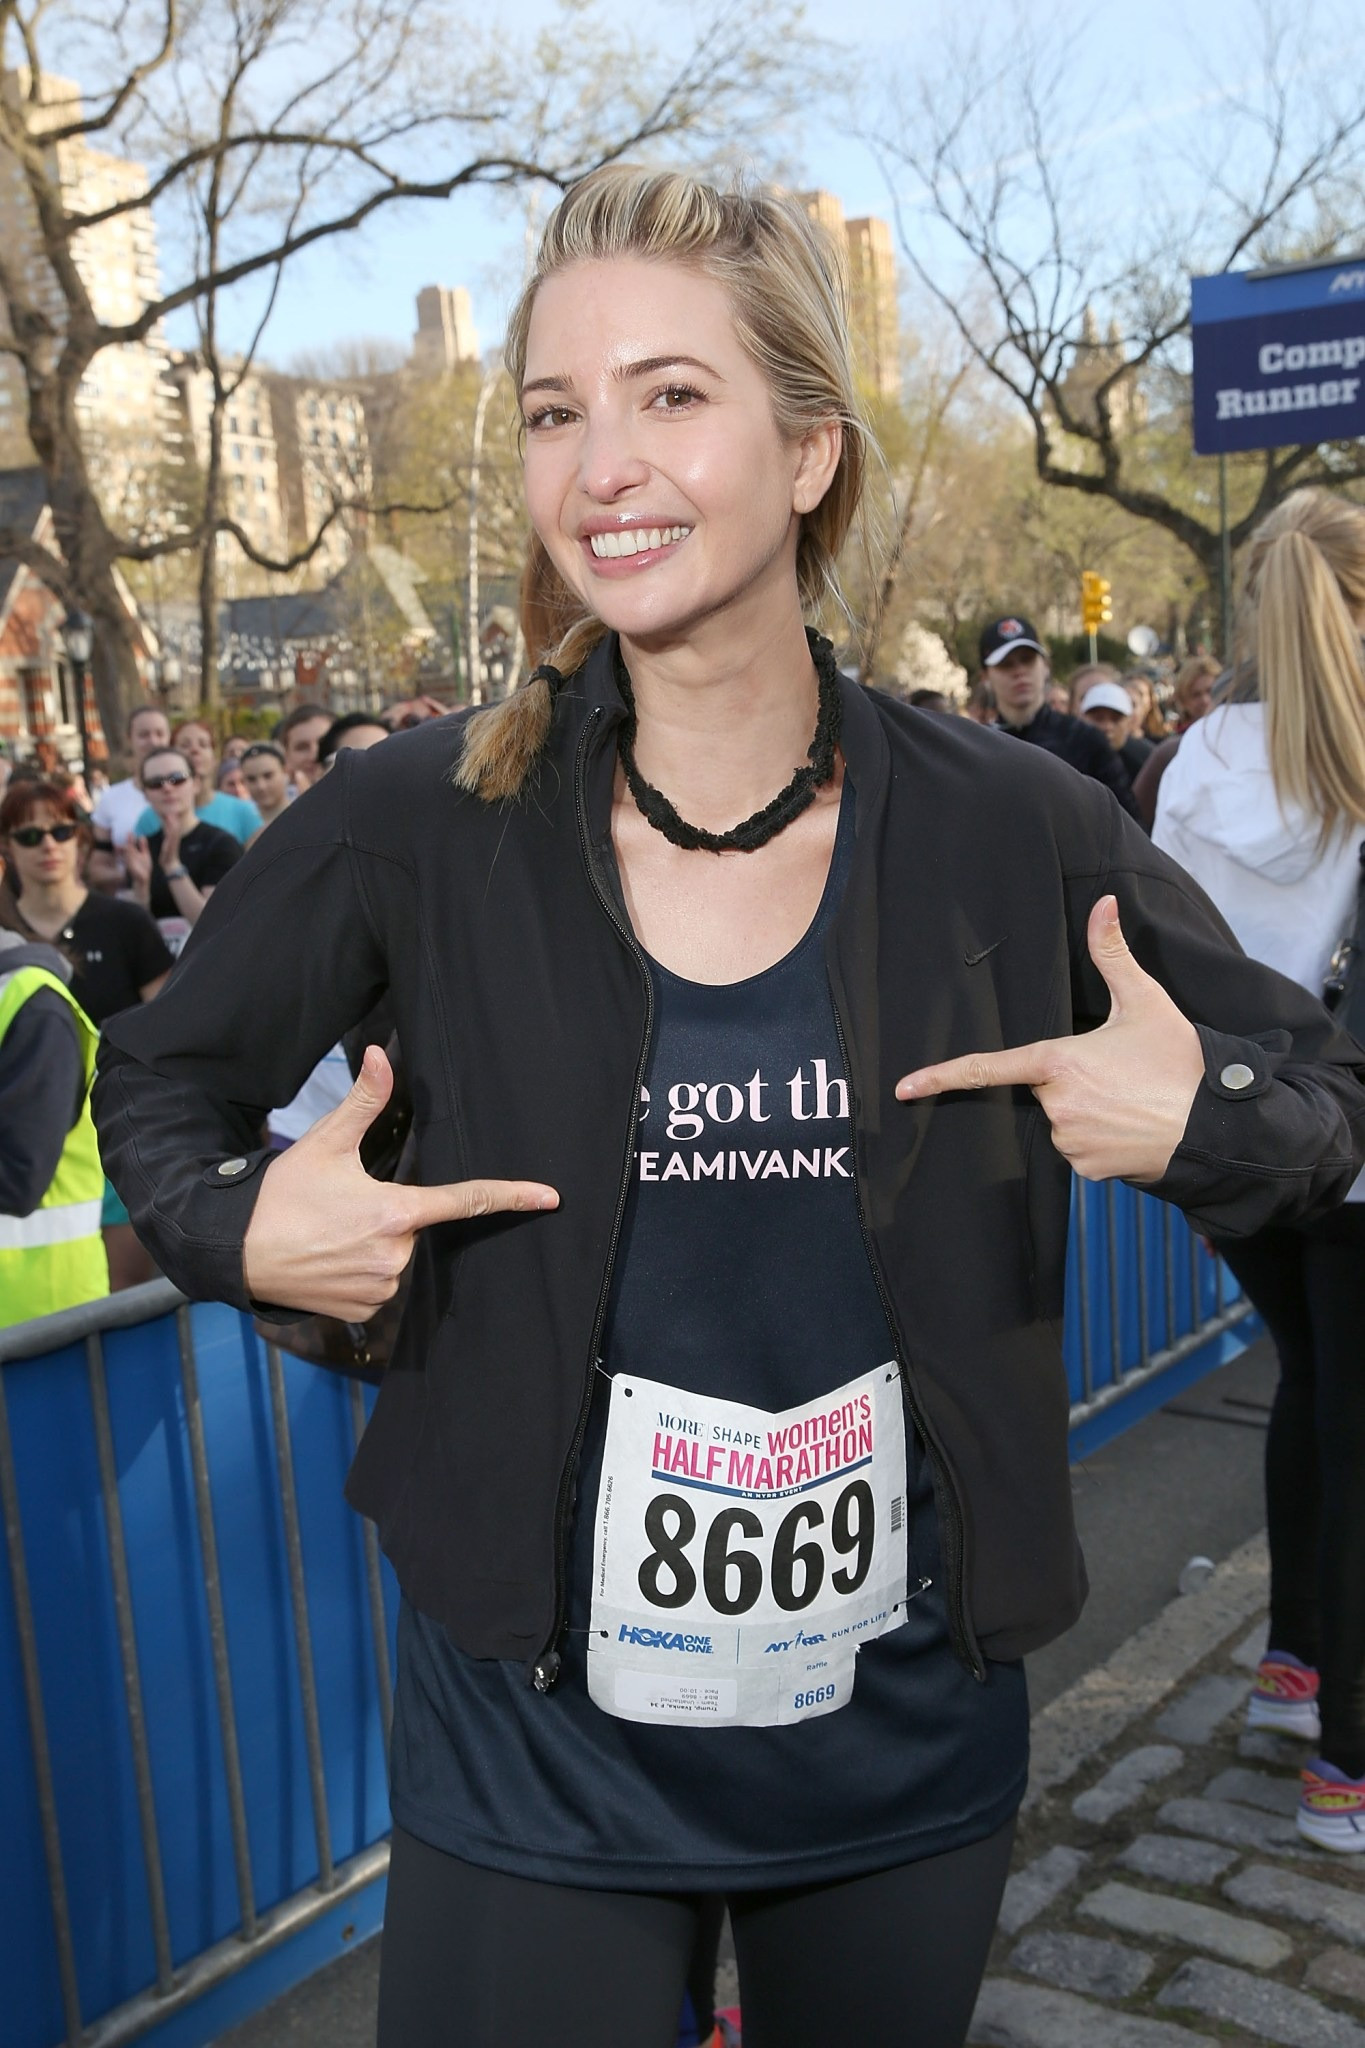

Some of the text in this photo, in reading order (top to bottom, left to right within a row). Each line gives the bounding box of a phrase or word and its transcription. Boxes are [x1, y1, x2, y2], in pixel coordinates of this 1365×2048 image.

[1258, 336, 1365, 375] Comp
[1215, 377, 1361, 420] Runner
[665, 1068, 772, 1141] got
[634, 1146, 854, 1182] EAMIVANK
[656, 1393, 872, 1457] MORE SHAPE women's
[652, 1420, 873, 1490] HALF MARATHON
[603, 1475, 614, 1525] 1.866.705.6626
[741, 1486, 803, 1499] AN NYRR EVENT
[637, 1479, 875, 1616] 8669
[618, 1624, 712, 1652] HOKA ONE
[831, 1627, 850, 1639] RUN
[852, 1619, 868, 1632] FOR
[870, 1611, 887, 1624] LIFE
[685, 1644, 713, 1654] ONE
[806, 1661, 828, 1672] Raffle
[794, 1683, 835, 1709] 8669
